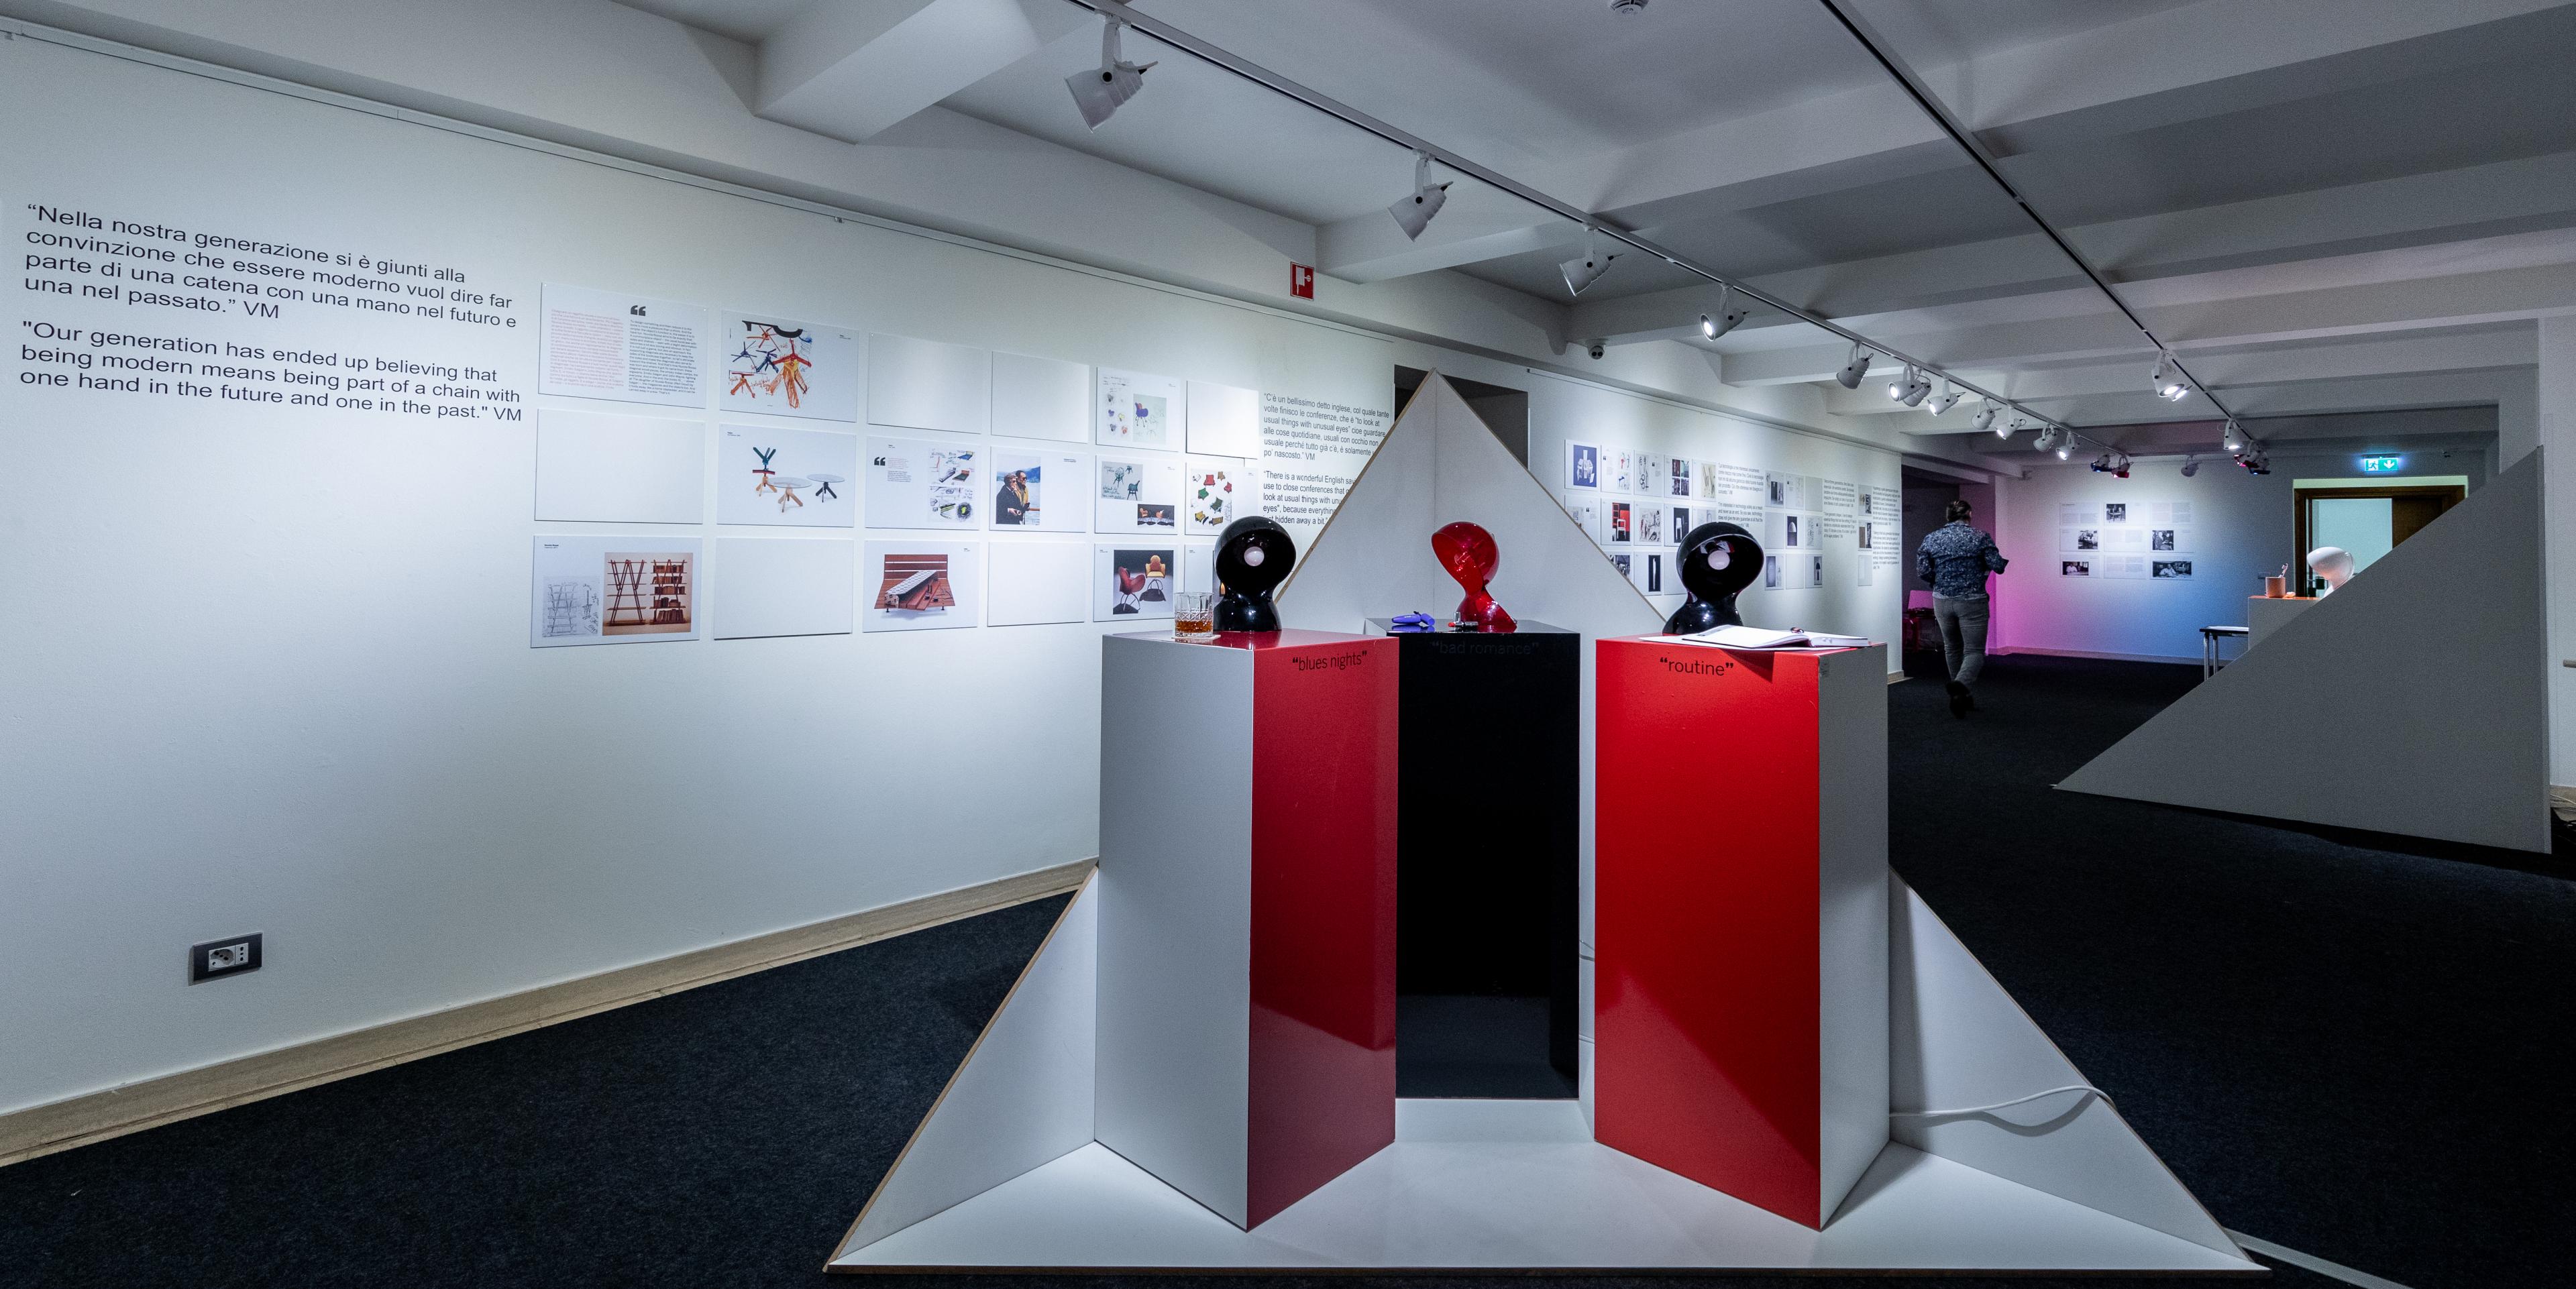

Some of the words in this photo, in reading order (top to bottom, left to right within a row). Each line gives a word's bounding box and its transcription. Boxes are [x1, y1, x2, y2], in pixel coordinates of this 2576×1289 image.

[28, 203, 103, 230] “Nella
[112, 220, 186, 242] nostra
[195, 233, 329, 263] generazione
[335, 252, 352, 266] si
[358, 254, 370, 269] è
[376, 259, 427, 278] giunti
[434, 268, 465, 284] alla
[26, 231, 176, 262] convinzione
[184, 251, 225, 269] che
[233, 260, 305, 280] essere
[313, 271, 400, 293] moderno
[407, 284, 444, 300] vuol
[450, 288, 484, 304] dire
[489, 293, 513, 309] far
[25, 254, 92, 274] parte
[101, 262, 121, 278] di
[131, 268, 174, 285] una
[183, 275, 258, 296] catena
[266, 286, 304, 301] con
[312, 292, 349, 307] una
[356, 298, 411, 315] mano
[417, 305, 443, 319] nel
[449, 307, 500, 326] futuro
[506, 318, 517, 328] e
[25, 278, 72, 295] una
[83, 284, 119, 300] nel
[128, 290, 236, 313] passato.”
[243, 300, 279, 319] VM
[23, 321, 83, 341] "Our
[90, 331, 217, 355] generation
[226, 341, 265, 359] has
[272, 349, 337, 367] ended
[345, 357, 368, 372] up
[376, 357, 458, 382] believing
[464, 366, 497, 382] that
[21, 344, 92, 370] being
[102, 355, 193, 374] modern
[202, 364, 276, 382] means
[284, 368, 339, 390] being
[347, 378, 385, 392] part
[391, 380, 410, 393] of
[415, 384, 426, 395] a
[432, 383, 480, 400] chain
[486, 388, 520, 403] with
[20, 372, 69, 387] one
[78, 372, 140, 392] hand
[149, 378, 168, 394] in
[176, 381, 213, 398] the
[220, 384, 283, 403] future
[290, 392, 329, 407] and
[335, 397, 373, 410] one
[380, 397, 395, 412] in
[402, 400, 431, 414] the
[437, 405, 488, 419] past."
[493, 406, 521, 422] VM
[1287, 397, 1315, 407] bellissimo
[1316, 401, 1330, 409] detto
[1332, 403, 1352, 414] inglese,
[1280, 406, 1298, 416] finisco
[1306, 411, 1338, 422] conferenze,
[1364, 418, 1373, 426] look
[1281, 417, 1298, 428] things
[1291, 431, 1322, 440] quotidiane,
[1320, 444, 1328, 452] già
[1345, 447, 1371, 455] solamente
[1300, 485, 1333, 493] conferences
[1325, 475, 1344, 485] English
[1283, 505, 1306, 513] because
[1302, 496, 1318, 504] things
[1297, 518, 1310, 526] away
[1292, 657, 1328, 671] “blues
[1330, 651, 1367, 670] nights”
[1660, 657, 1733, 676] “routine”
